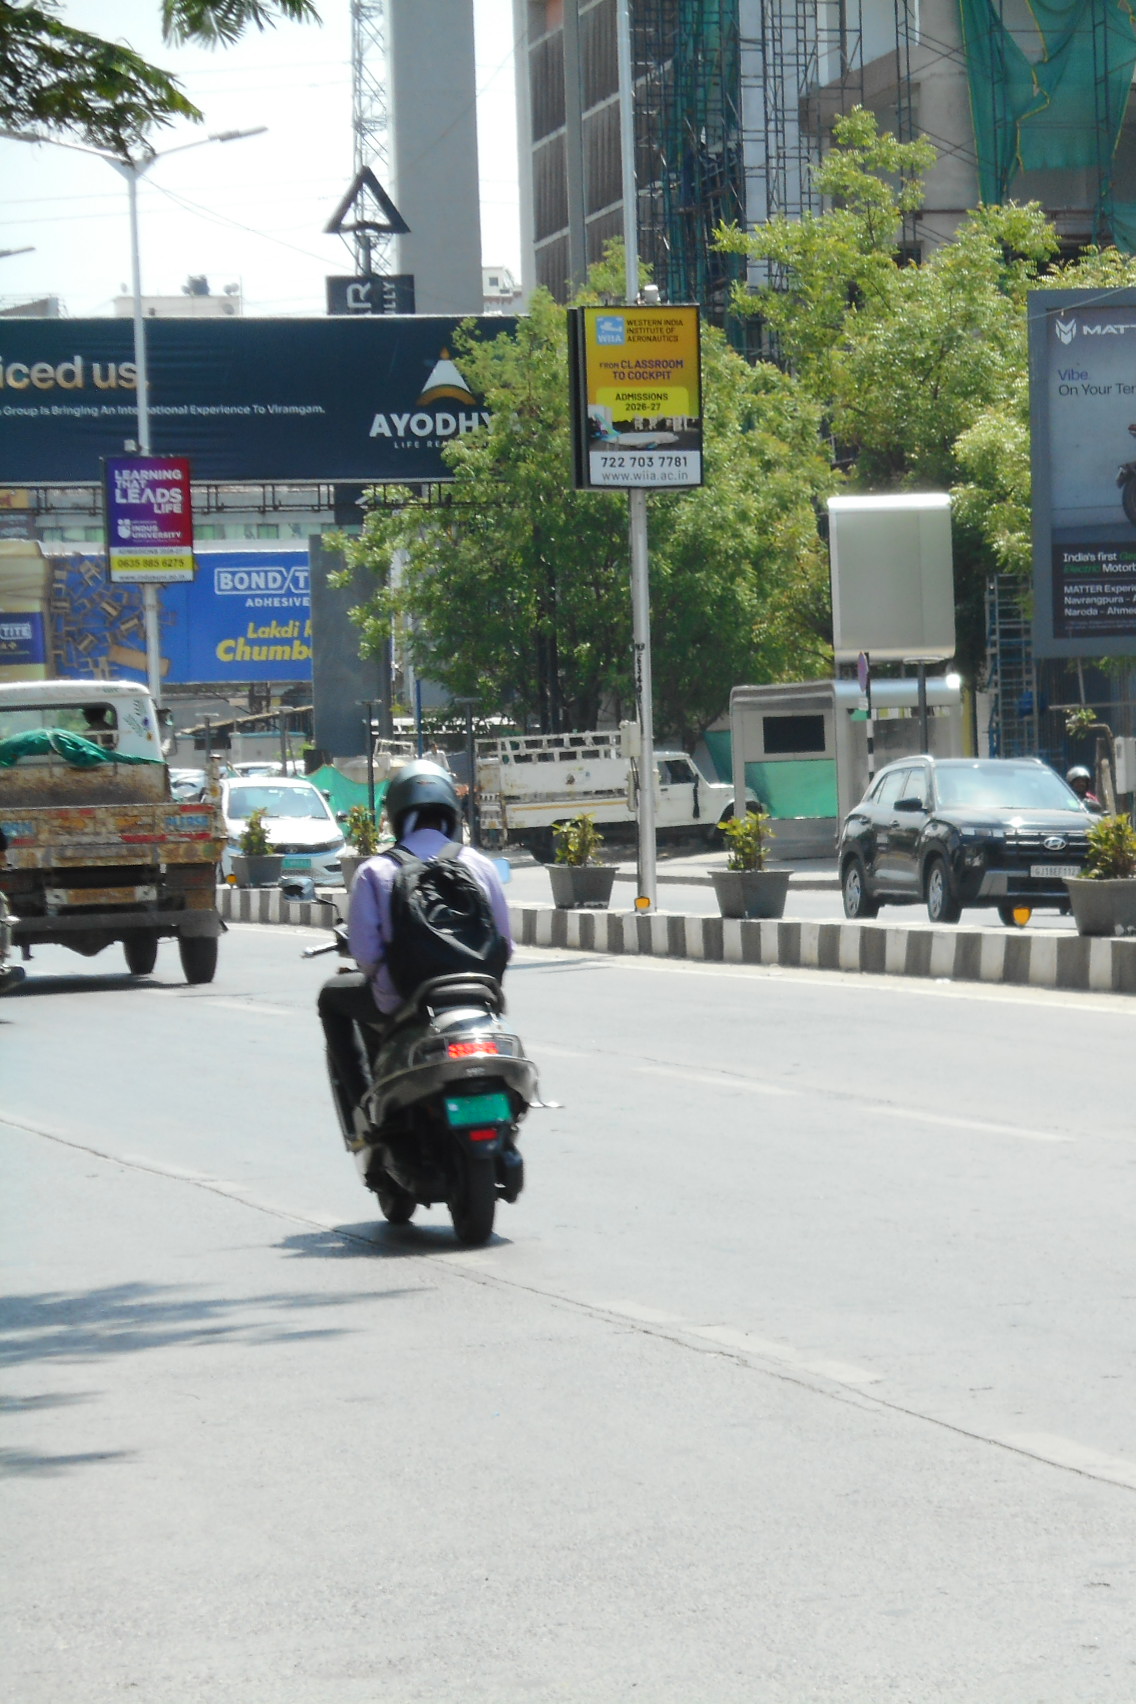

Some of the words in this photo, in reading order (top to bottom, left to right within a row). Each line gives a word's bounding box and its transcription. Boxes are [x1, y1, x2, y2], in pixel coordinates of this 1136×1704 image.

[597, 334, 623, 344] WIIA
[621, 359, 684, 369] CLASSROOM
[613, 372, 625, 381] TO
[627, 371, 673, 380] COCKPIT
[1058, 383, 1078, 396] On
[1081, 382, 1113, 396] Your
[615, 393, 669, 401] ADMISSIONS
[101, 405, 115, 415] An
[117, 405, 188, 415] Inteational
[190, 405, 250, 417] Experience
[252, 404, 265, 414] To
[625, 403, 661, 411] 2026-27
[394, 440, 419, 449] LIFE
[601, 457, 625, 468] 722
[631, 457, 654, 467] 703
[659, 456, 688, 467] 7781
[115, 469, 182, 480] LEARNING
[602, 470, 688, 481] www.wiia.ac.in
[115, 480, 147, 489] THAT
[115, 488, 182, 504] LEADS
[153, 503, 182, 514] LIFE
[1063, 552, 1096, 563] India's
[1098, 551, 1117, 561] first
[1064, 585, 1102, 594] MATTER
[245, 597, 311, 608] ADHESIVE
[1064, 595, 1124, 606] Navrangpura
[1064, 607, 1098, 617] Naroda
[247, 620, 300, 639] Lakdi
[216, 637, 312, 662] Chumb
